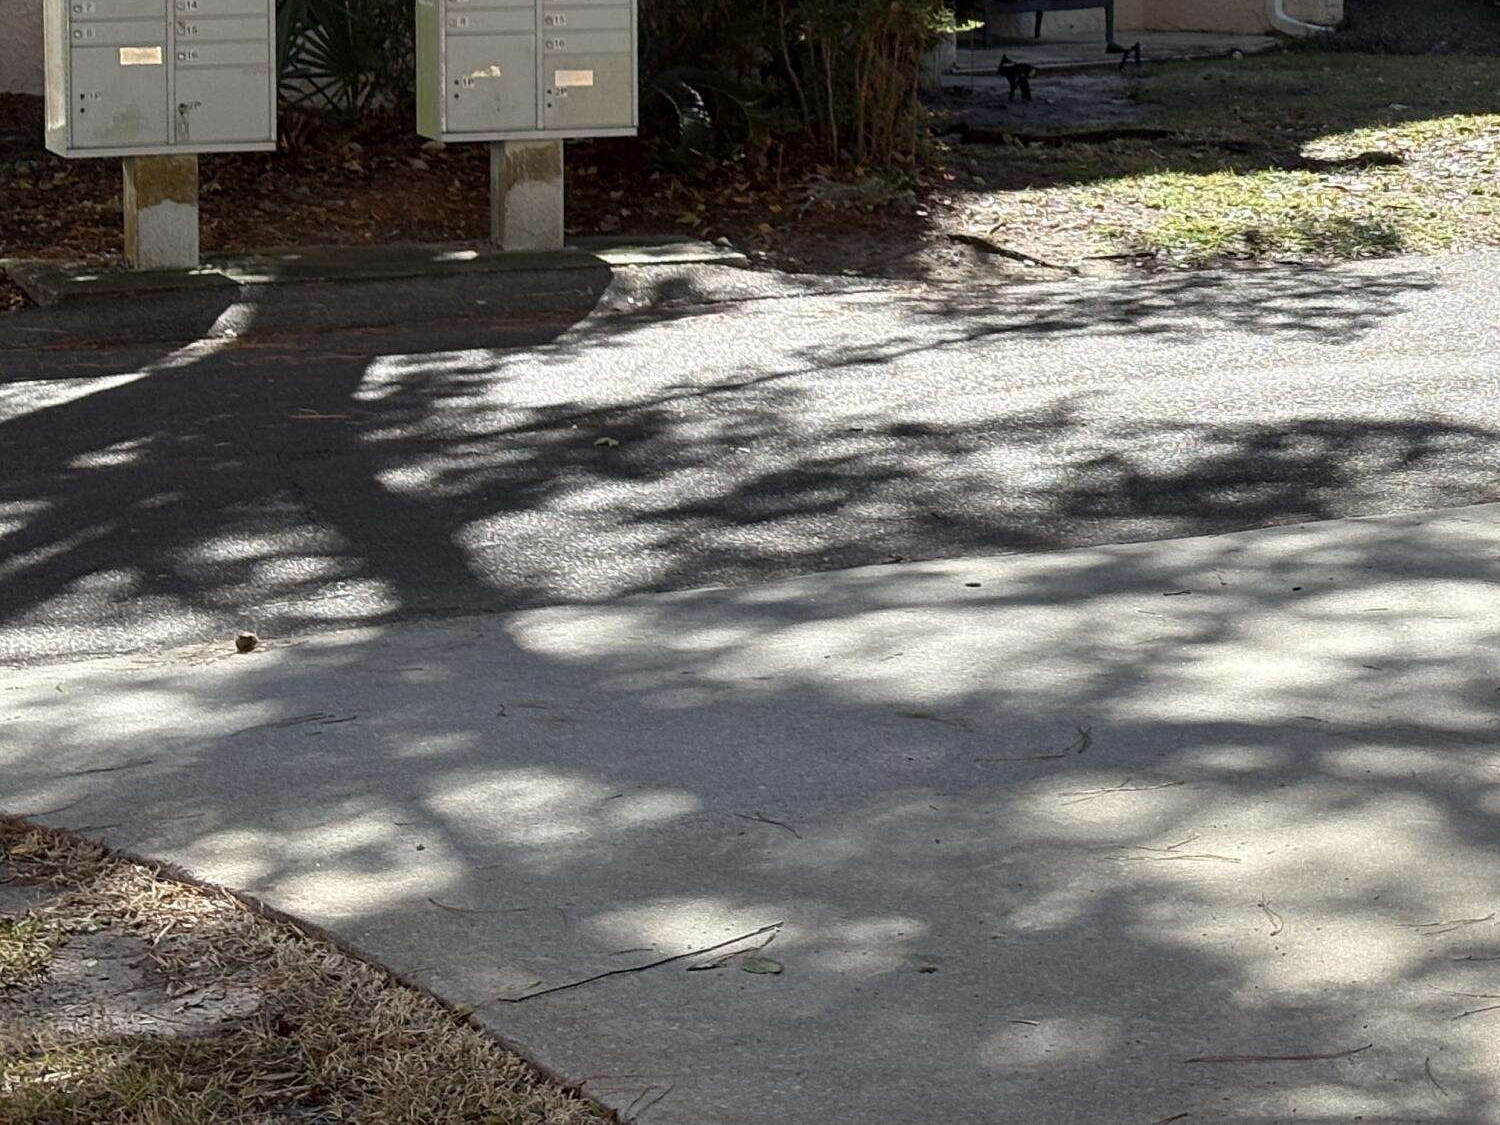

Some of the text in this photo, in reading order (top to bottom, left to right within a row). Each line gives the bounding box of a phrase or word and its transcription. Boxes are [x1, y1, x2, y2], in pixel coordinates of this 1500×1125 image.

[187, 0, 197, 10] 14
[555, 16, 565, 24] 15
[187, 26, 198, 35] 15
[555, 39, 565, 47] 16
[188, 51, 198, 60] 16
[463, 78, 475, 86] 1P
[555, 88, 568, 96] 2P
